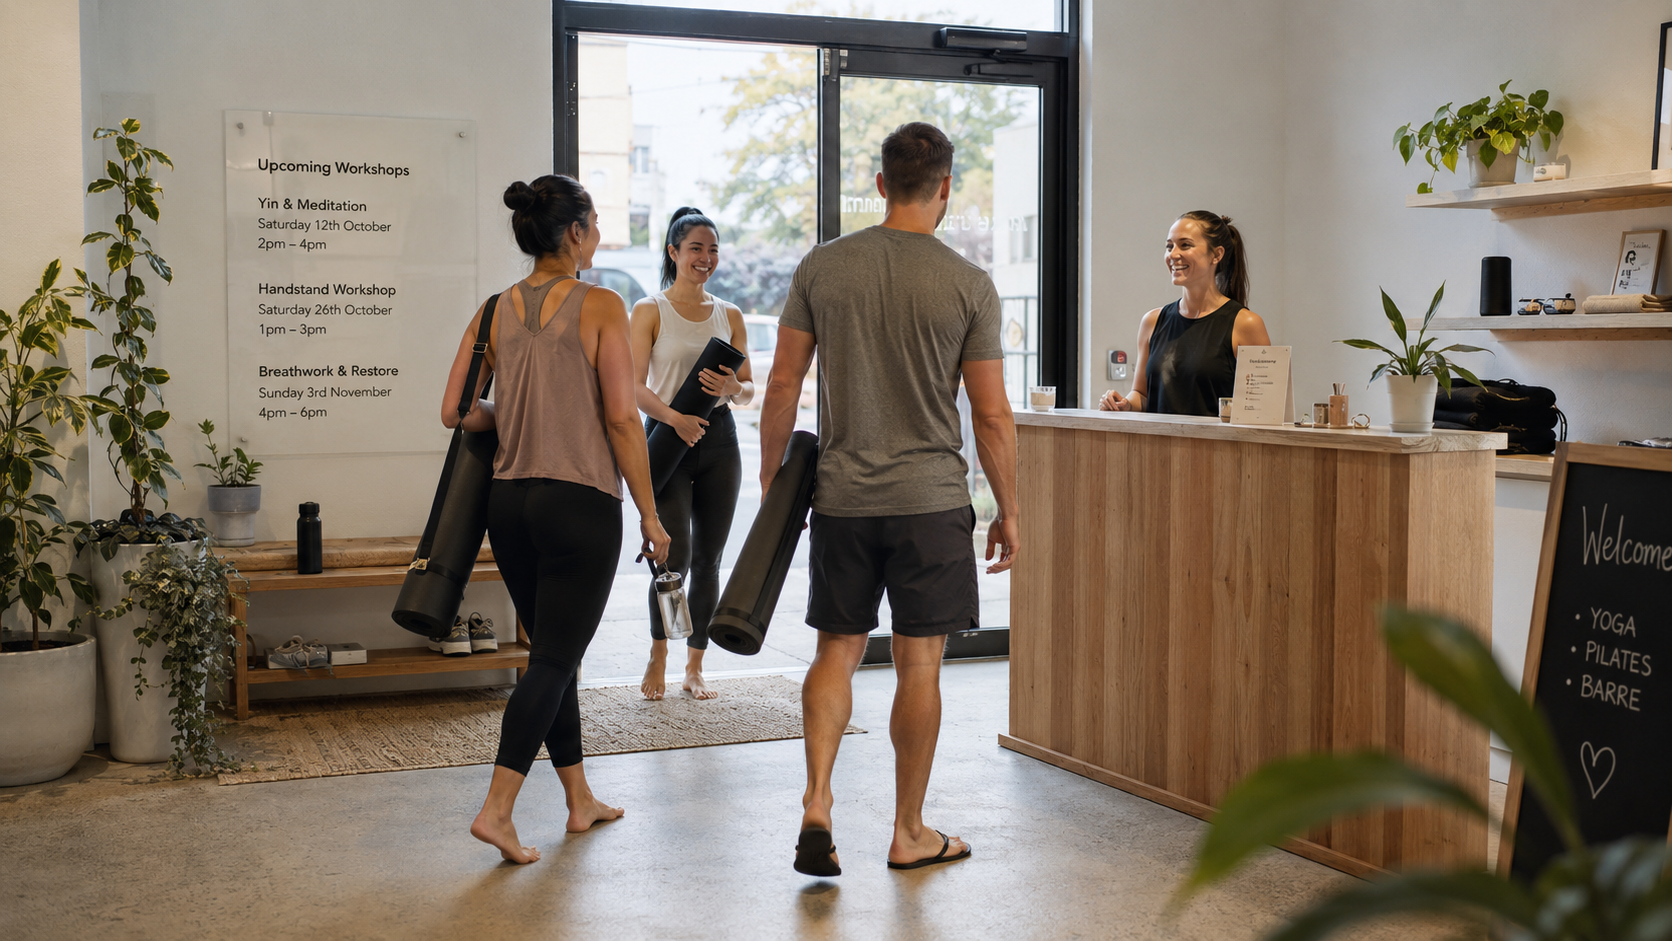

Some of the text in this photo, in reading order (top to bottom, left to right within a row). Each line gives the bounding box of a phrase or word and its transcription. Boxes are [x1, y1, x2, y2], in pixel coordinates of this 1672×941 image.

[257, 157, 410, 179] Upcoming Workshops
[257, 196, 367, 212] Yin & Meditation
[257, 217, 392, 234] Saturday 12th October
[257, 236, 286, 252] 2pm
[299, 238, 327, 253] 4pm
[258, 282, 397, 299] Handstand Workshop
[258, 303, 393, 318] Saturday 26th October
[259, 323, 286, 337] 1pm
[299, 323, 327, 337] 3pm
[258, 364, 399, 378] Breathwork & Restore
[258, 385, 393, 401] Sunday 3rd November
[258, 406, 287, 422] 4pm
[299, 406, 328, 421] 6pm
[1582, 503, 1672, 571] Welcome
[1590, 606, 1636, 638] YOGA
[1585, 640, 1652, 677] PILATES
[1580, 674, 1641, 711] BARRE
